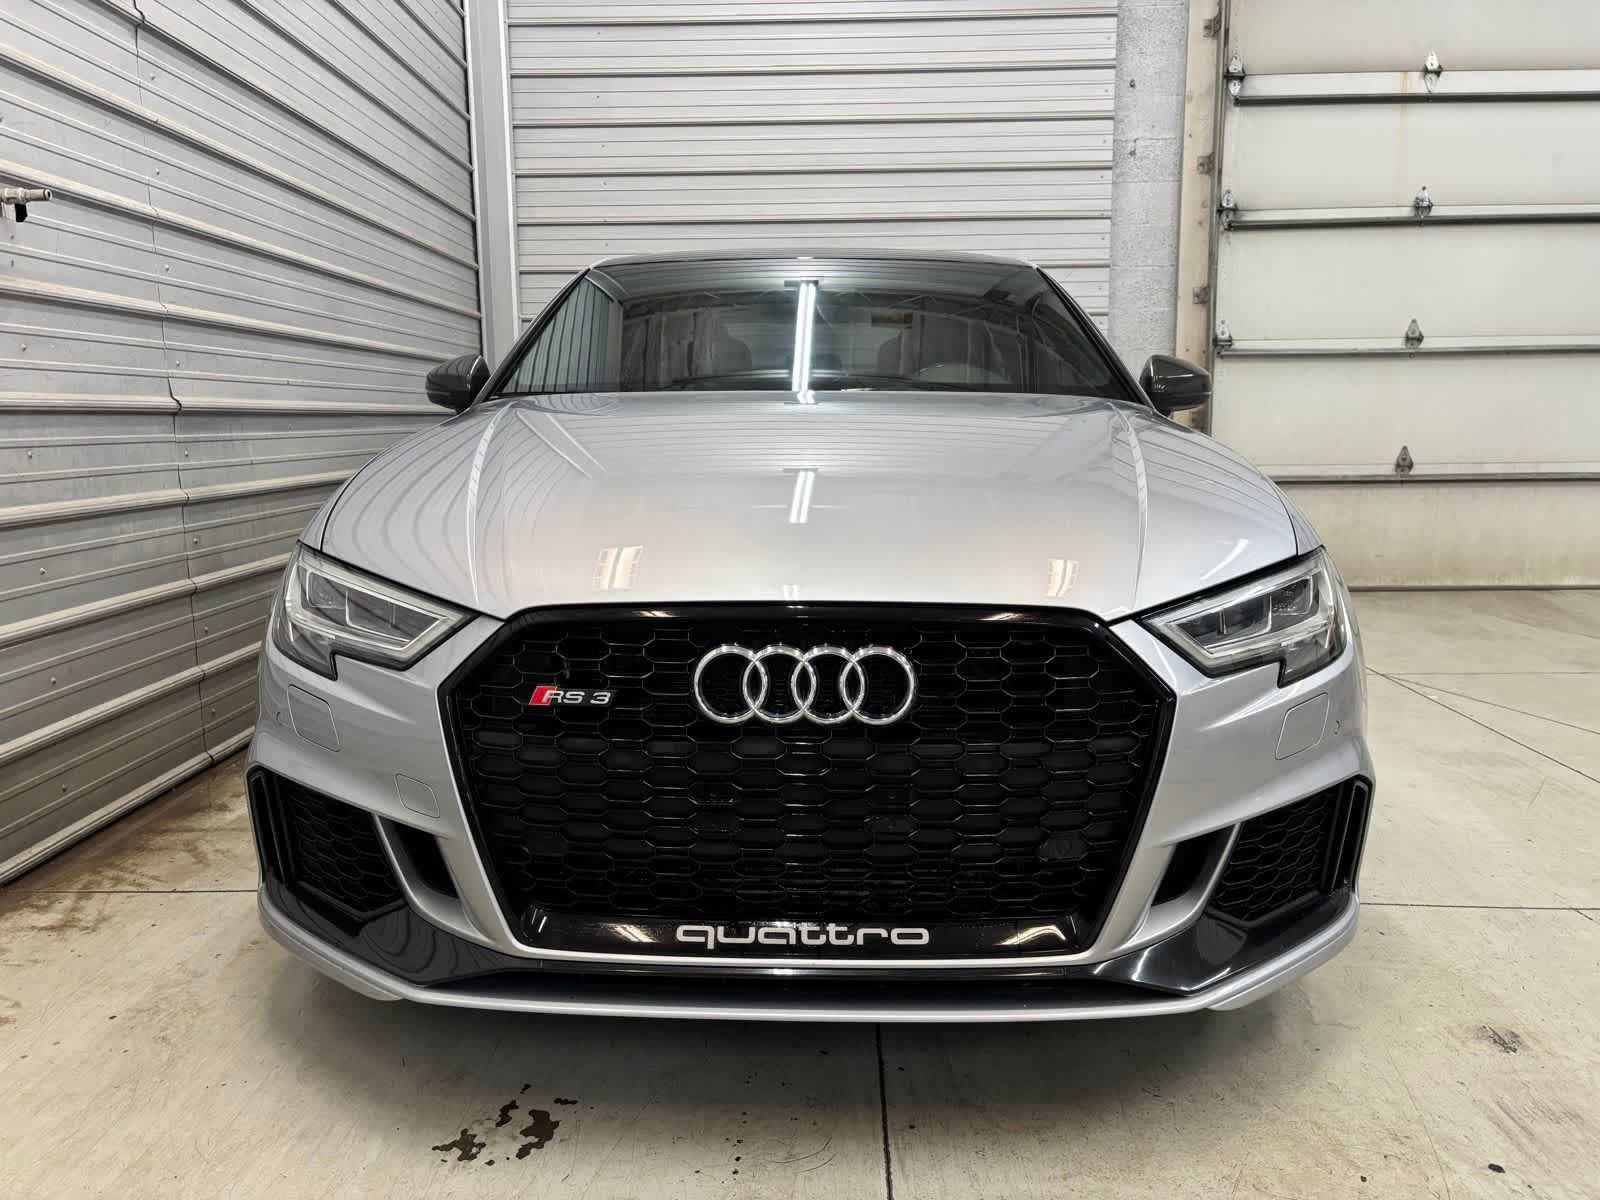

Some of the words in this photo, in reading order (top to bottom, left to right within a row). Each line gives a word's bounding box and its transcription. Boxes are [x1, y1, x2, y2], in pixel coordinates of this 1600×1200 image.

[541, 690, 585, 704] RS
[590, 692, 611, 704] 3
[676, 922, 930, 949] quattro
